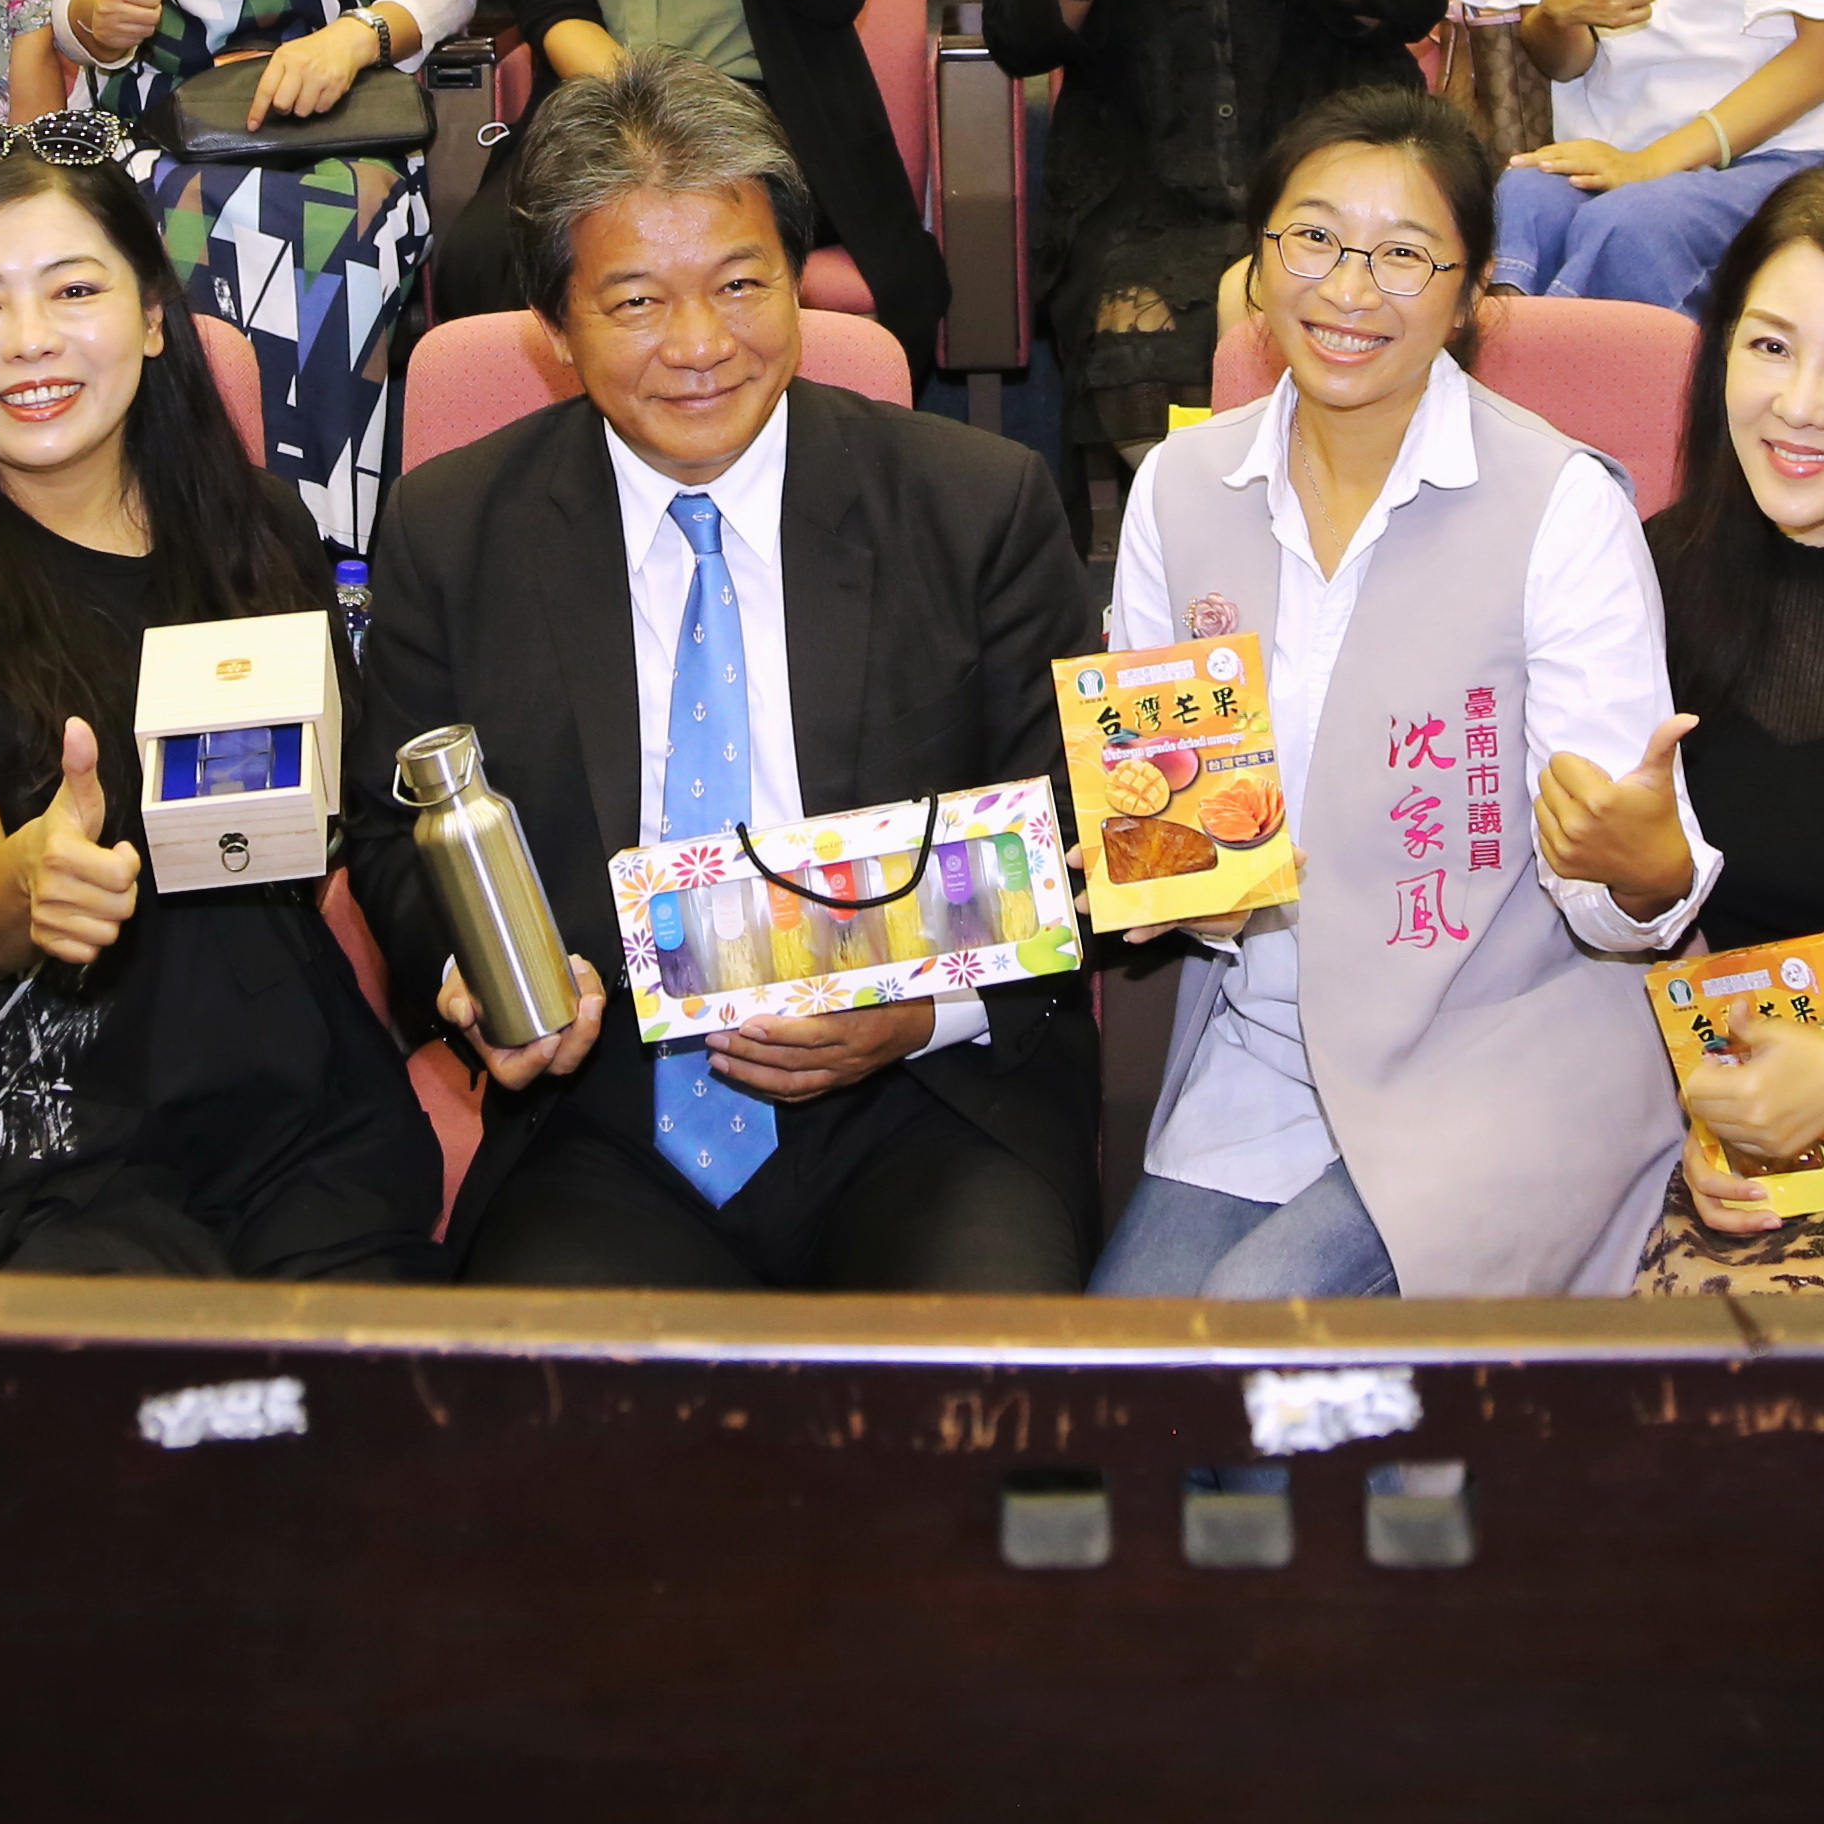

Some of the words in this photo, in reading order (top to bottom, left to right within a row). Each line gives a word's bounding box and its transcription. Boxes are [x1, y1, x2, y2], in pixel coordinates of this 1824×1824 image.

[1096, 686, 1240, 736] 台灣芒果
[1465, 686, 1503, 872] 臺南市議員
[1386, 712, 1470, 949] 沈家鳳
